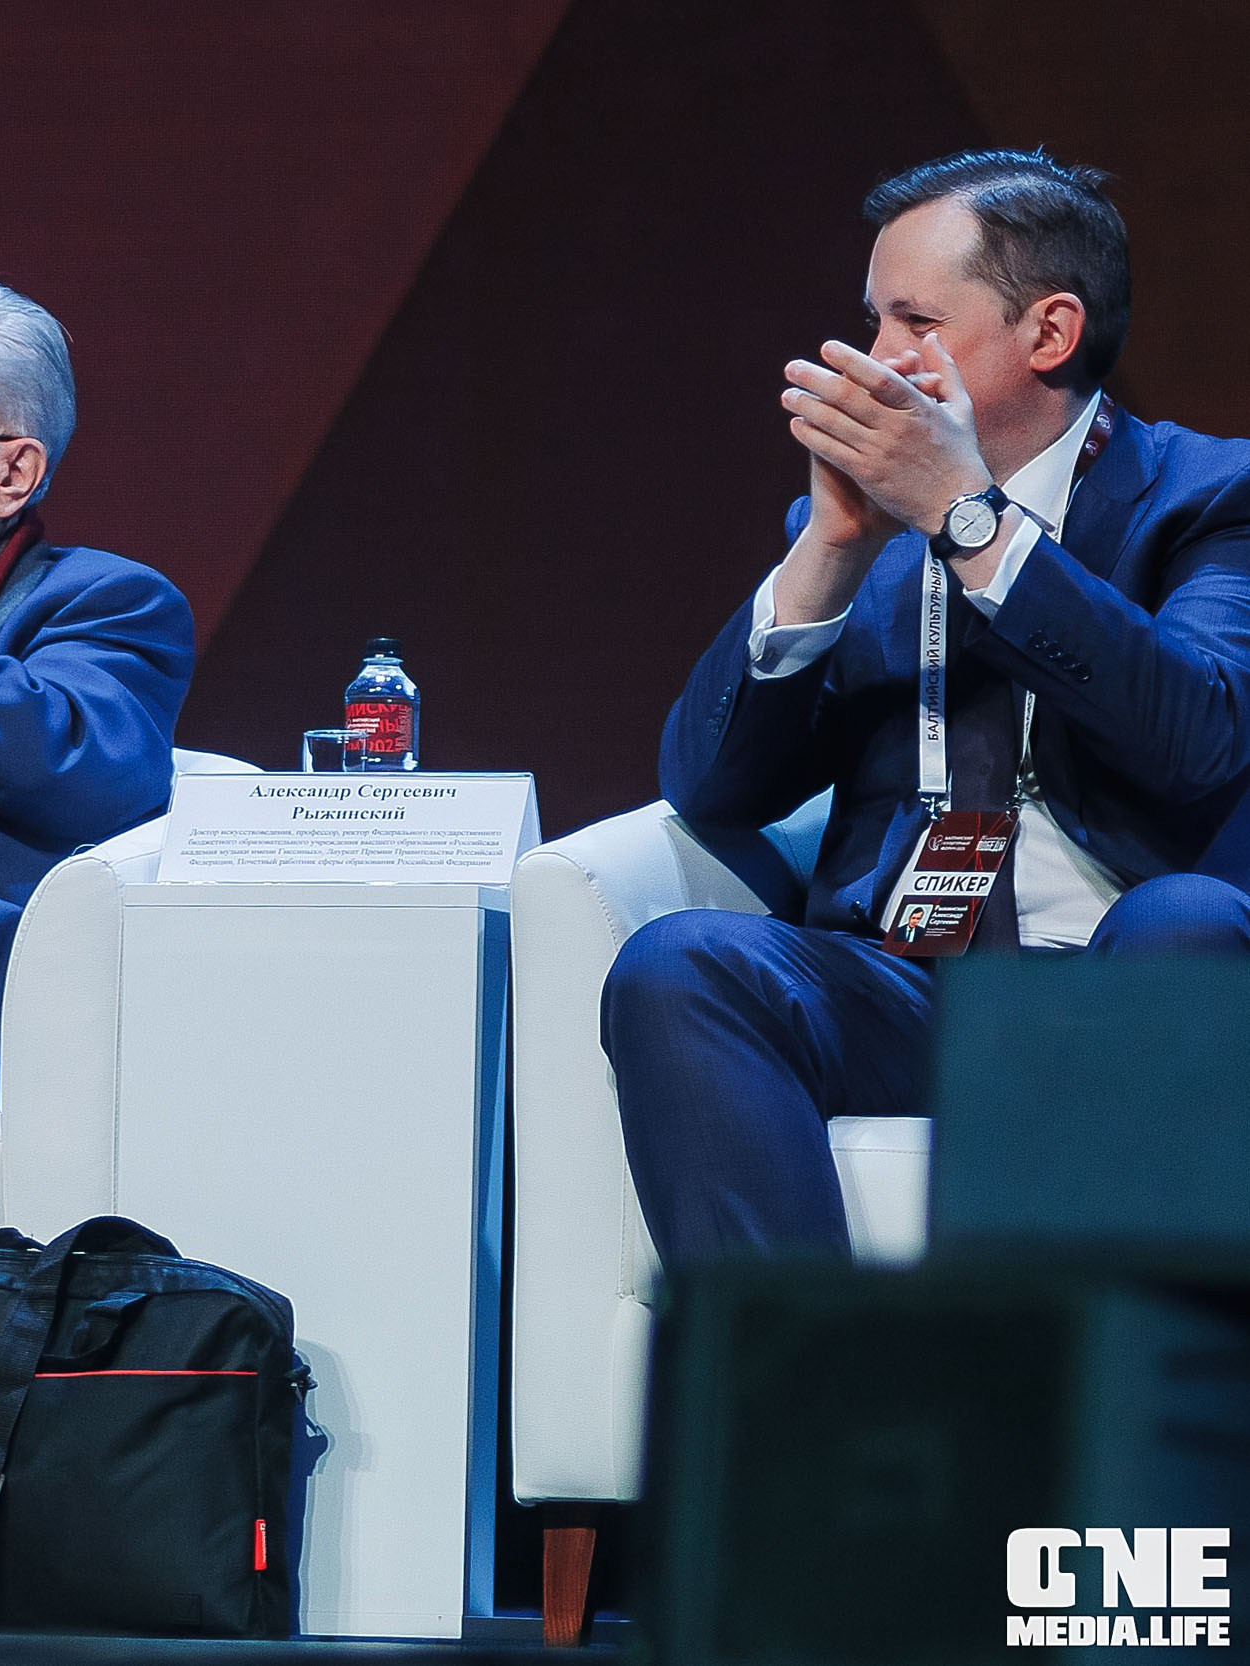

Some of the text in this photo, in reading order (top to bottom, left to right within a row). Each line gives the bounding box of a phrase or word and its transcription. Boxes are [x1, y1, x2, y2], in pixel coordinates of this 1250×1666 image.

[928, 568, 943, 646] КУЛЬТУРНЫЙ
[926, 649, 940, 741] БАЛТИЙСКИЙ
[249, 784, 458, 800] Александр Сергеевич
[292, 806, 405, 820] Рыжинский
[913, 875, 990, 892] СПИКЕР
